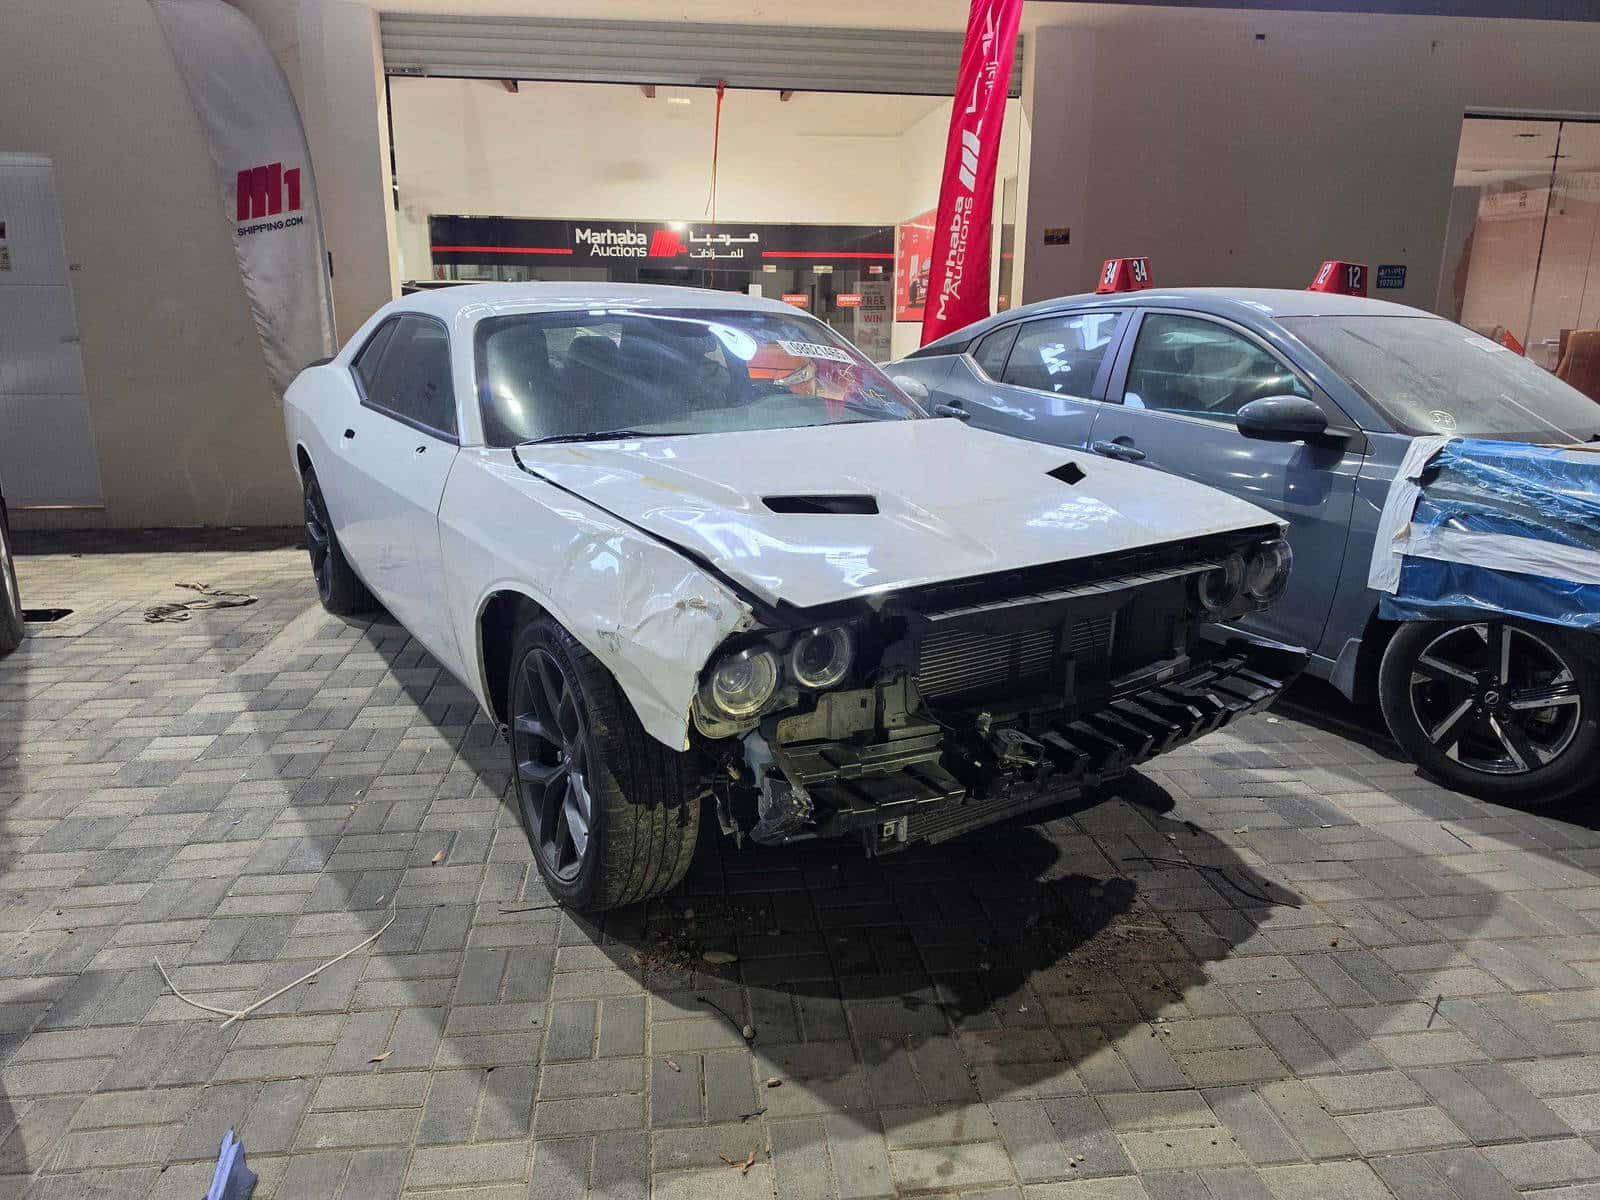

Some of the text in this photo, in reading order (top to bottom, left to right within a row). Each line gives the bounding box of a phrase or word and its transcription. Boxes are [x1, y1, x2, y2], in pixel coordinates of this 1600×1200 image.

[236, 162, 301, 222] M1
[237, 216, 304, 237] SHIPPING.COM
[575, 228, 647, 244] Marhaba
[689, 230, 759, 245] مرحبا
[590, 243, 647, 258] Auctions
[936, 196, 964, 321] Marhaba
[950, 197, 973, 300] Auctions
[1103, 261, 1118, 285] 34
[1133, 259, 1148, 282] 34
[1348, 265, 1361, 289] 12
[863, 314, 882, 324] WIN
